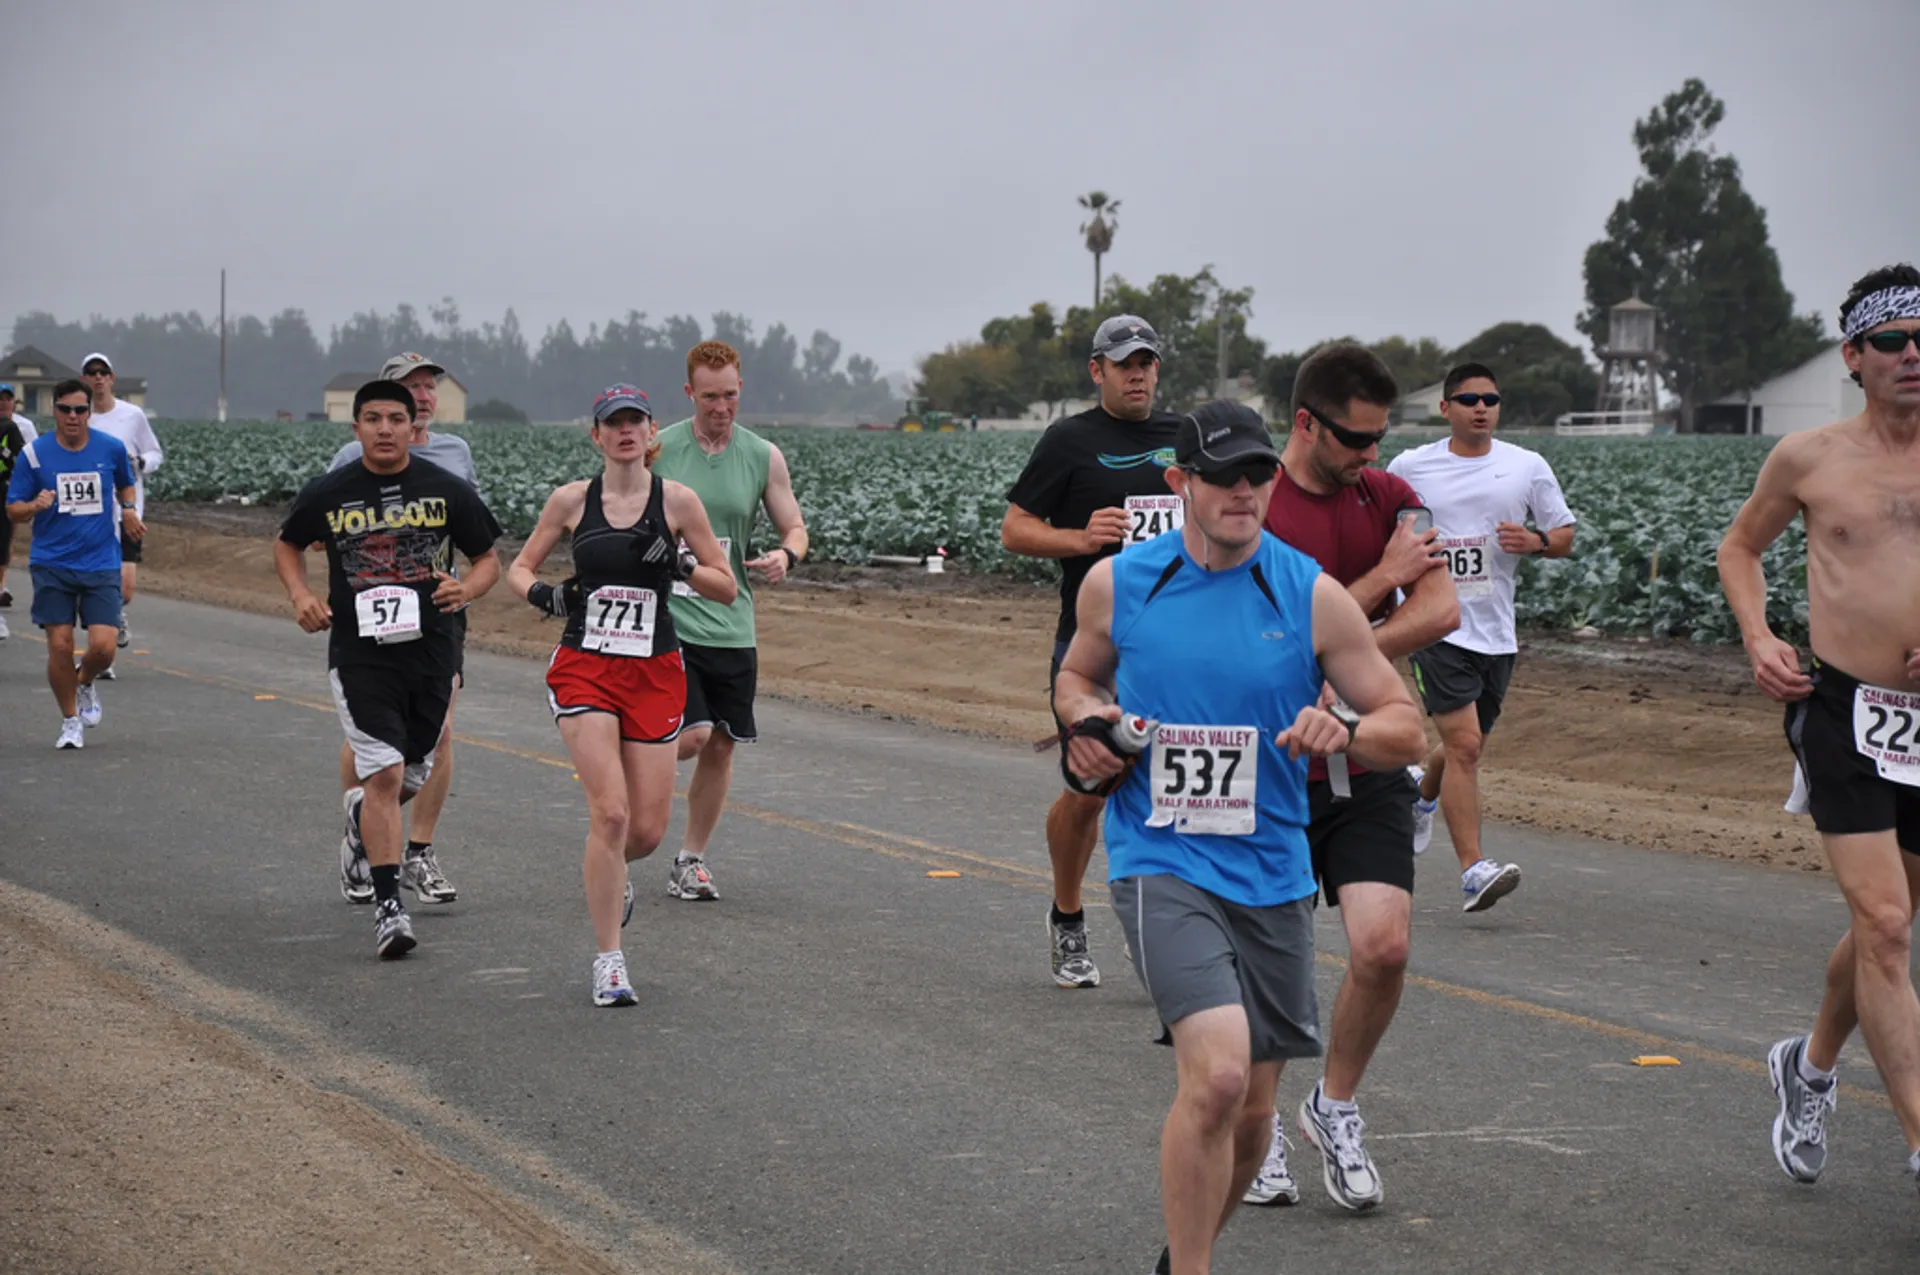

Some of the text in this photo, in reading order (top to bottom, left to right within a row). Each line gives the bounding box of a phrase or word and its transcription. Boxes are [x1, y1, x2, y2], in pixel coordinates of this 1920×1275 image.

[64, 482, 96, 500] 194
[326, 497, 447, 535] VOLCOM
[1132, 510, 1173, 542] 241
[626, 591, 653, 603] VALLEY
[373, 597, 402, 626] 57
[598, 598, 643, 631] 771
[1863, 689, 1908, 709] SALINAS
[1158, 728, 1251, 748] SALINAS VALLEY
[1164, 747, 1242, 797] 537
[1156, 796, 1249, 810] HALF MARATHON
